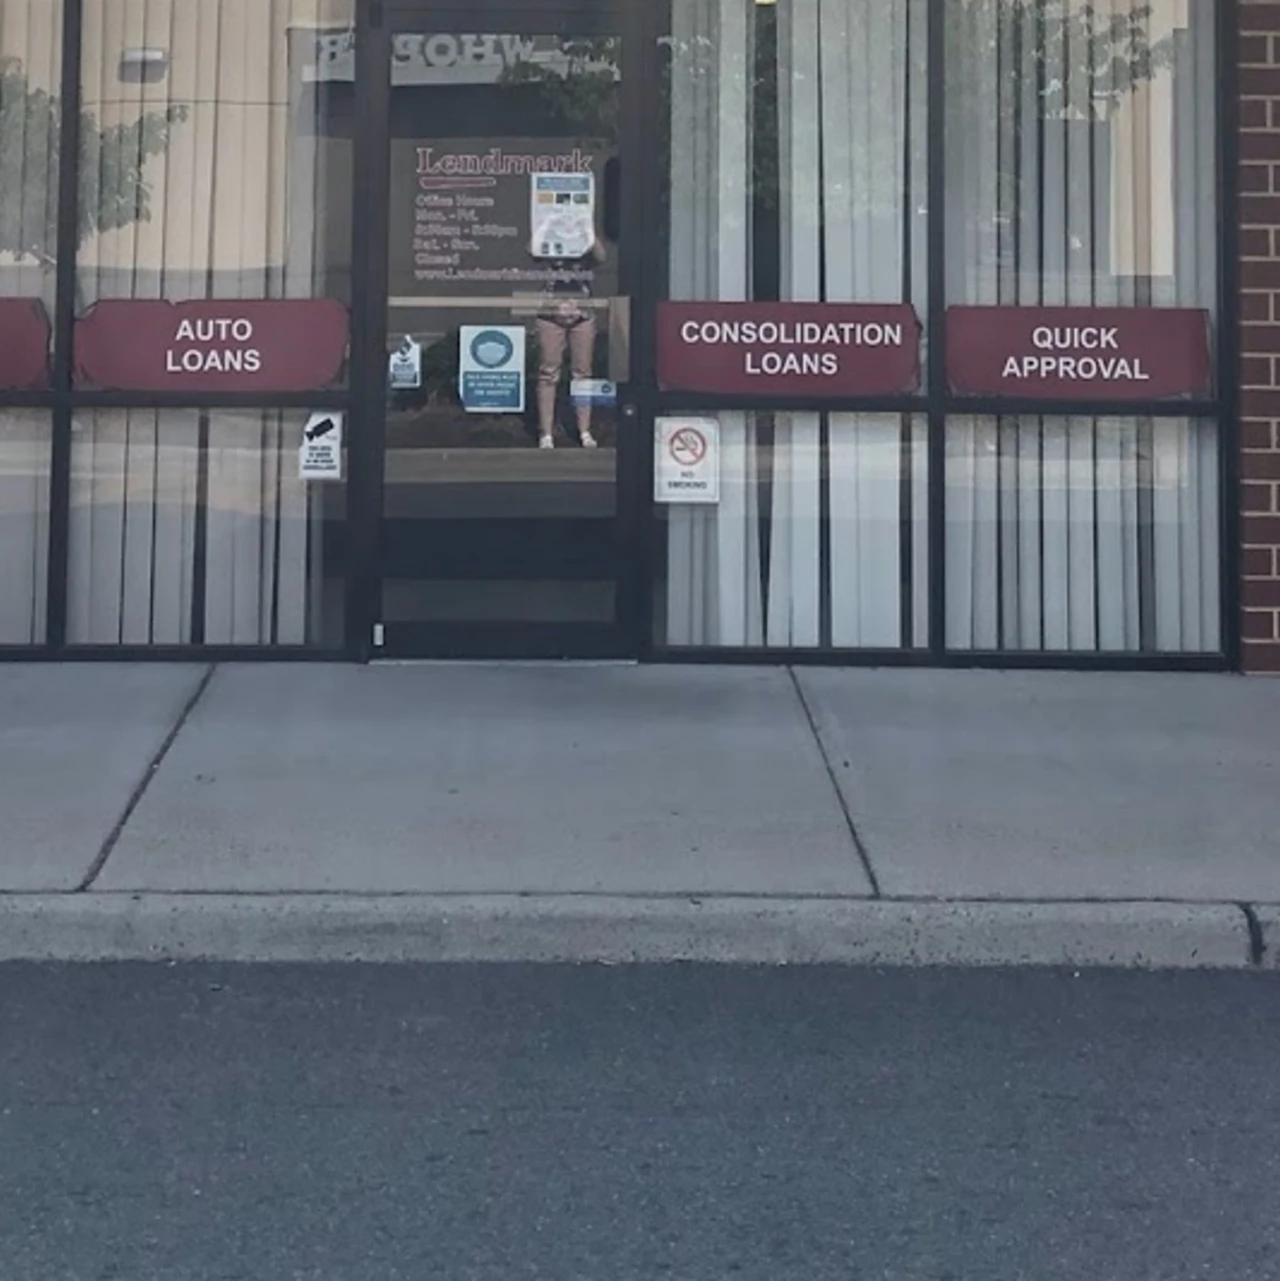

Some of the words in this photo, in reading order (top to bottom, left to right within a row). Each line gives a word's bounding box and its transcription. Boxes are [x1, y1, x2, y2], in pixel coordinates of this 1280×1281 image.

[416, 148, 593, 175] Lendmark
[175, 318, 253, 342] AUTO
[681, 320, 902, 346] CONSOLIDATION
[1032, 326, 1118, 351] QUICK
[166, 348, 261, 372] LOANS
[745, 352, 838, 375] LOANS
[1002, 356, 1150, 381] APPROVAL
[668, 481, 708, 490] SMOKING
